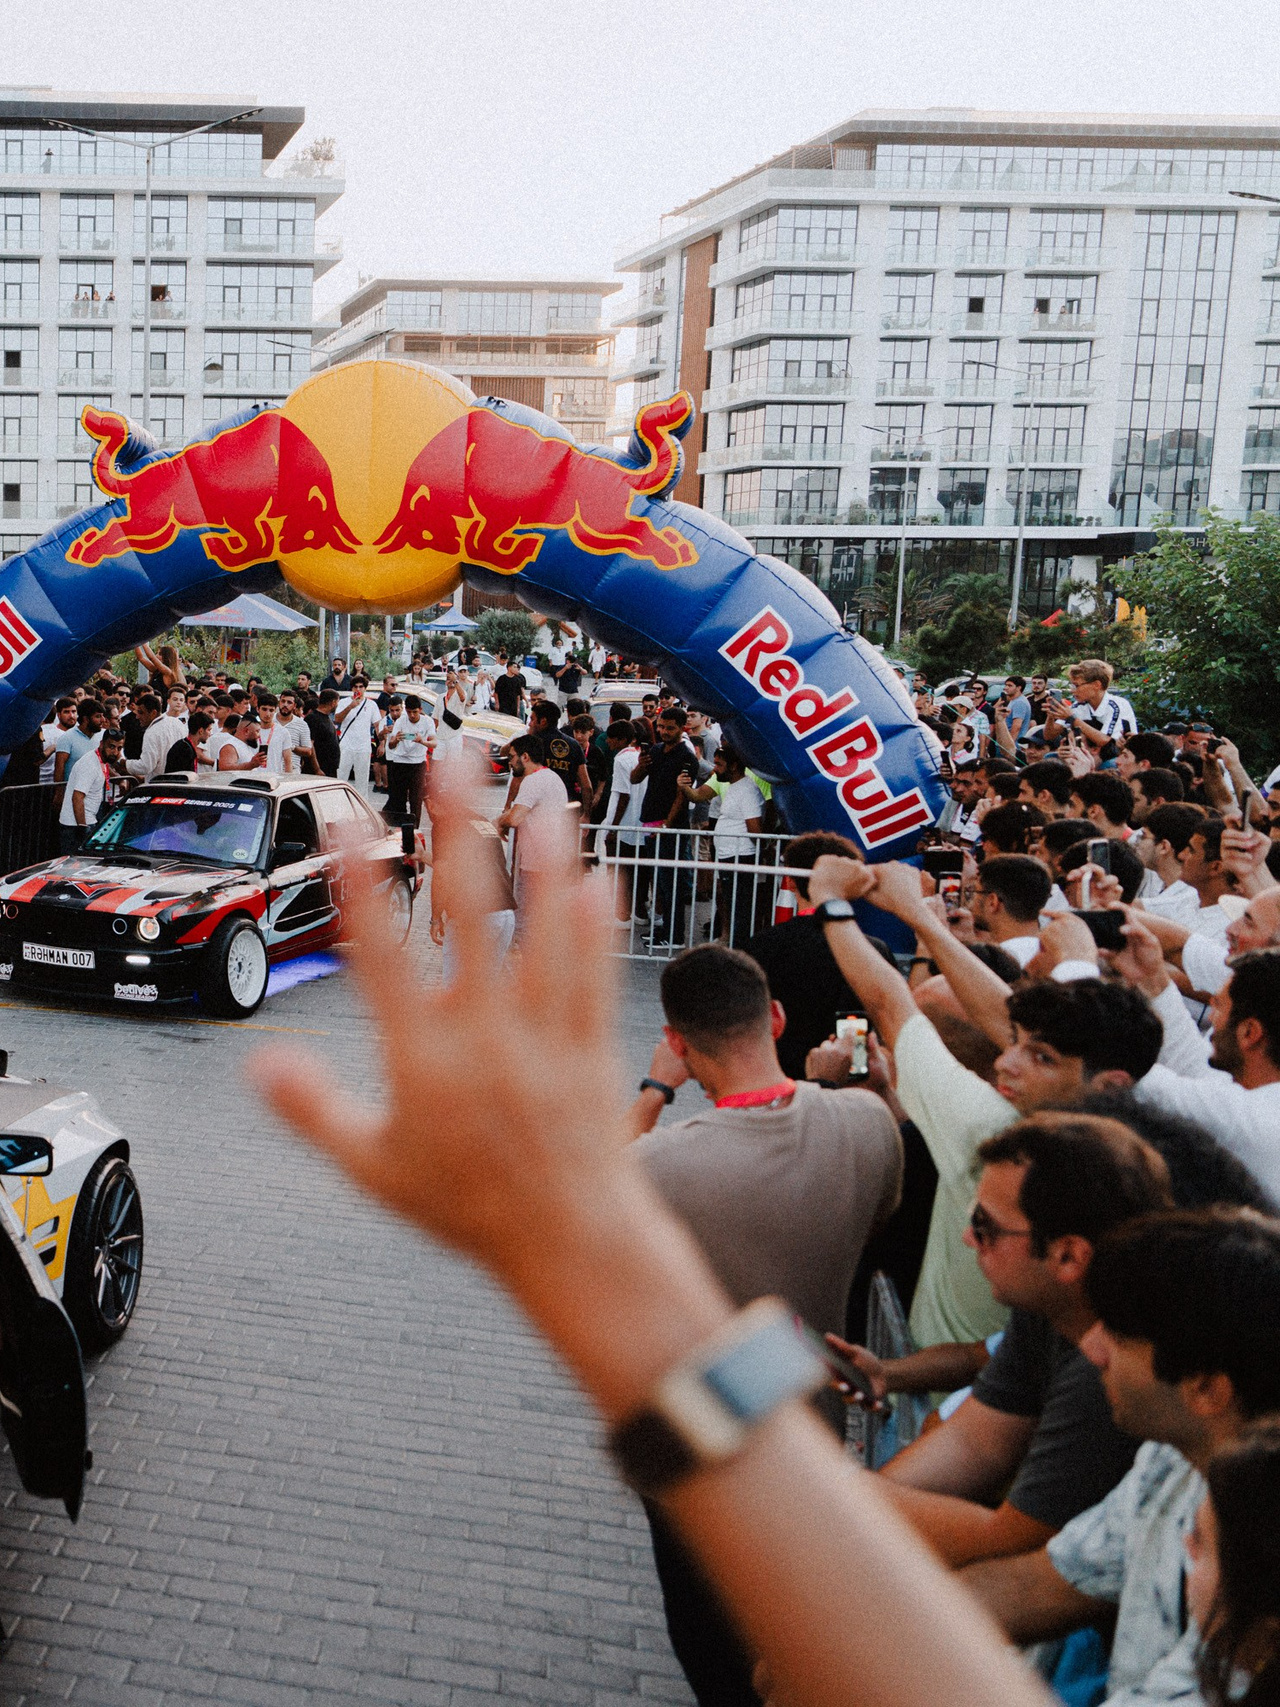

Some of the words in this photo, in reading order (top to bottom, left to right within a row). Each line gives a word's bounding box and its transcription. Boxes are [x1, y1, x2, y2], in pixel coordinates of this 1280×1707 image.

[719, 606, 860, 741] Red
[806, 715, 936, 850] Bull
[235, 850, 246, 858] OK
[30, 946, 69, 965] RƏHMAN
[72, 952, 92, 967] 007
